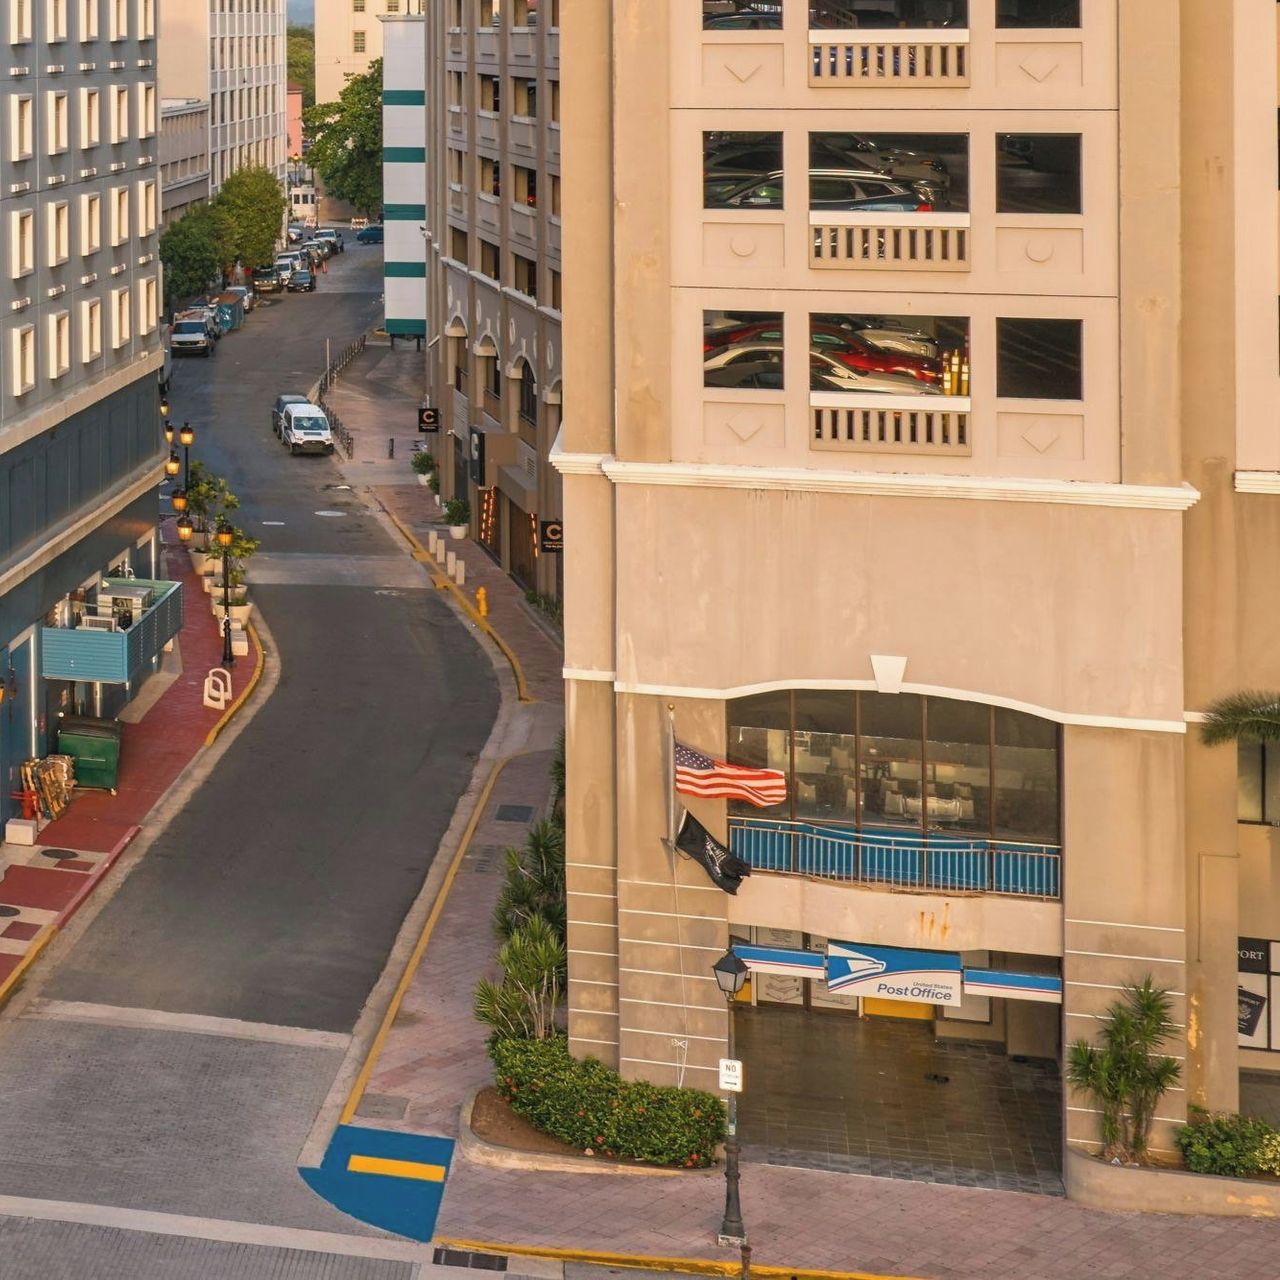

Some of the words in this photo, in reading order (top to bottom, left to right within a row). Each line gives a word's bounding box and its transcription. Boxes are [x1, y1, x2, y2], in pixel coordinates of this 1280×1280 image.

[546, 524, 561, 540] C
[1237, 949, 1264, 960] ORT
[725, 1064, 737, 1072] NO
